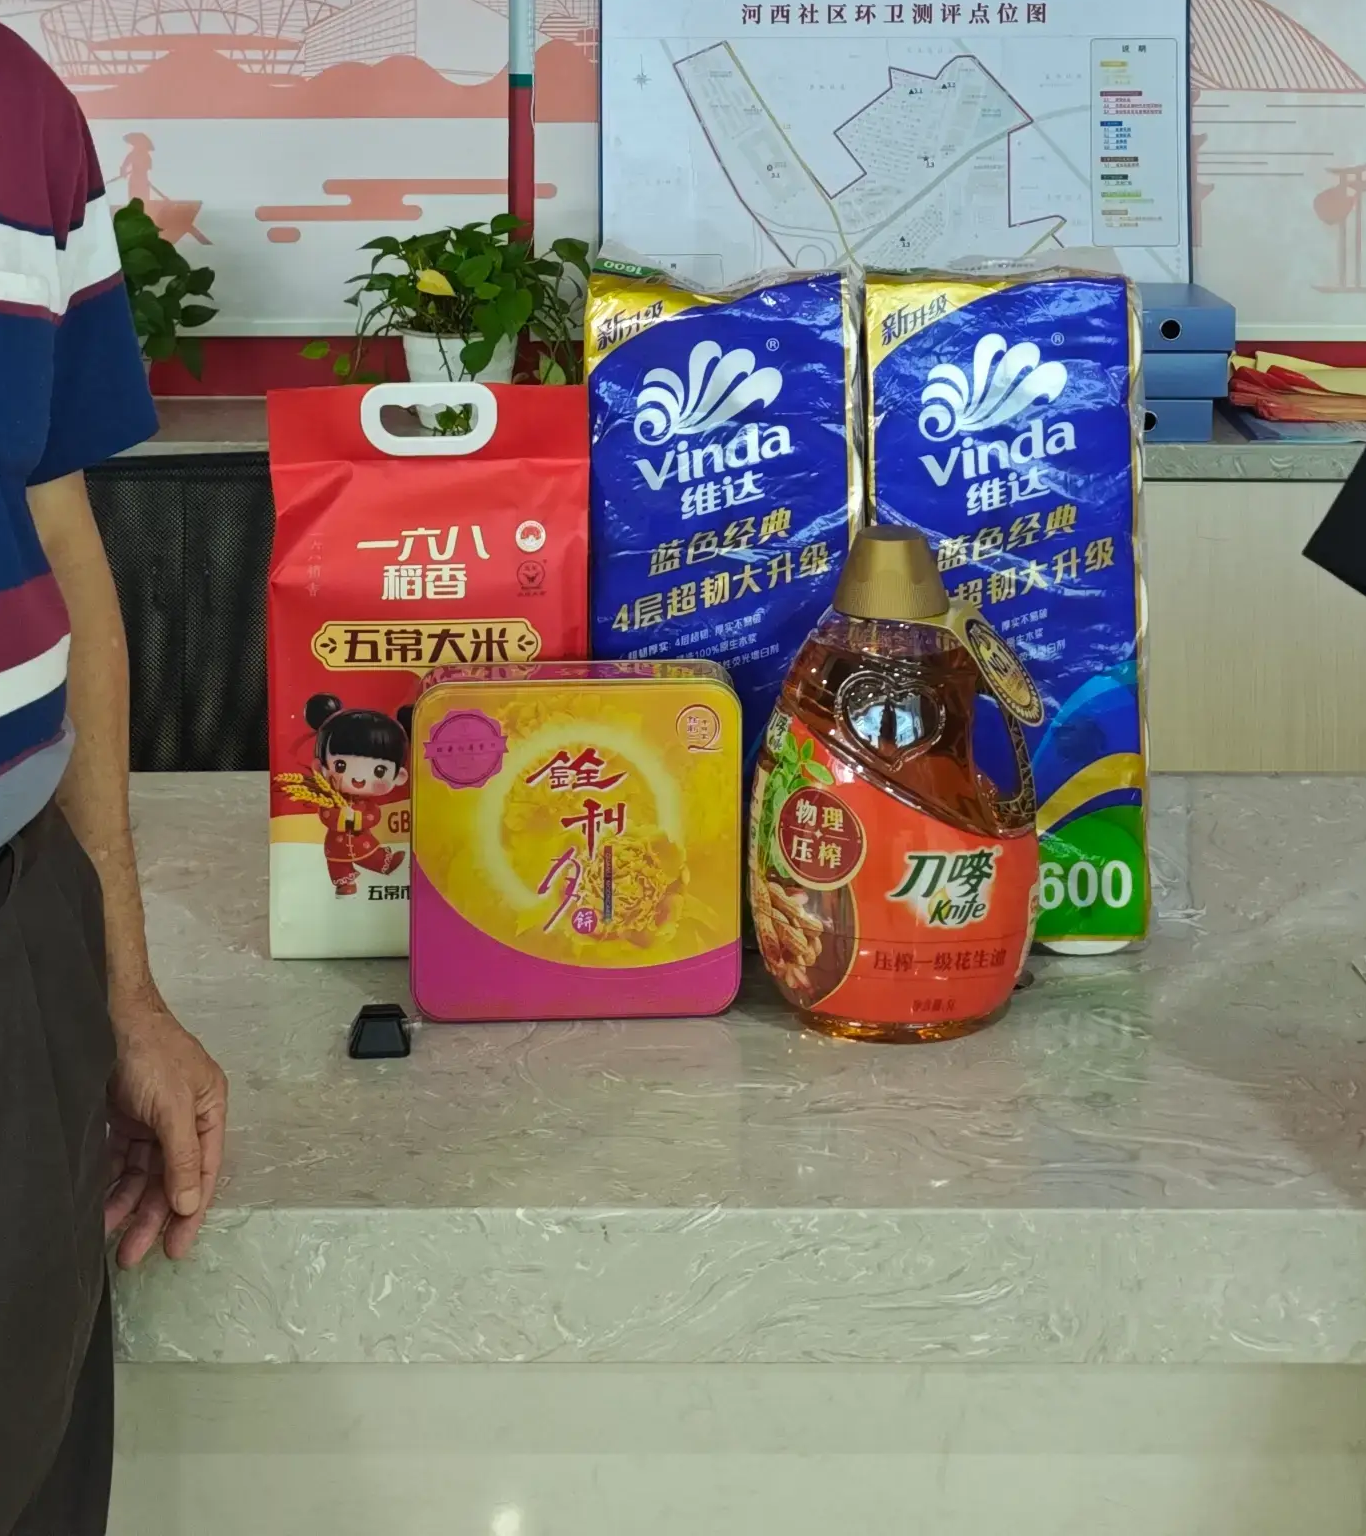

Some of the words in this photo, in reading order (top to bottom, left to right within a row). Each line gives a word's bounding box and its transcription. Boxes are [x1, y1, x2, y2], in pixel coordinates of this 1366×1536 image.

[741, 3, 1047, 25] 河西社区环卫测评点位图
[597, 300, 664, 352] 新升级
[881, 293, 948, 346] 新升级
[681, 470, 765, 520] 维达
[966, 466, 1051, 516] 维达
[356, 525, 491, 562] 一六八
[647, 507, 792, 578] 蓝色经典
[936, 503, 1077, 573] 蓝色经典
[380, 564, 468, 601] 稻香
[611, 541, 832, 633] 4层超韧大升级
[343, 627, 510, 664] 五常大米
[387, 810, 411, 834] GB
[795, 798, 845, 832] 物理
[790, 838, 842, 869] 压榨
[929, 894, 986, 925] Knife
[873, 949, 1008, 973] 压榨一级花生油
